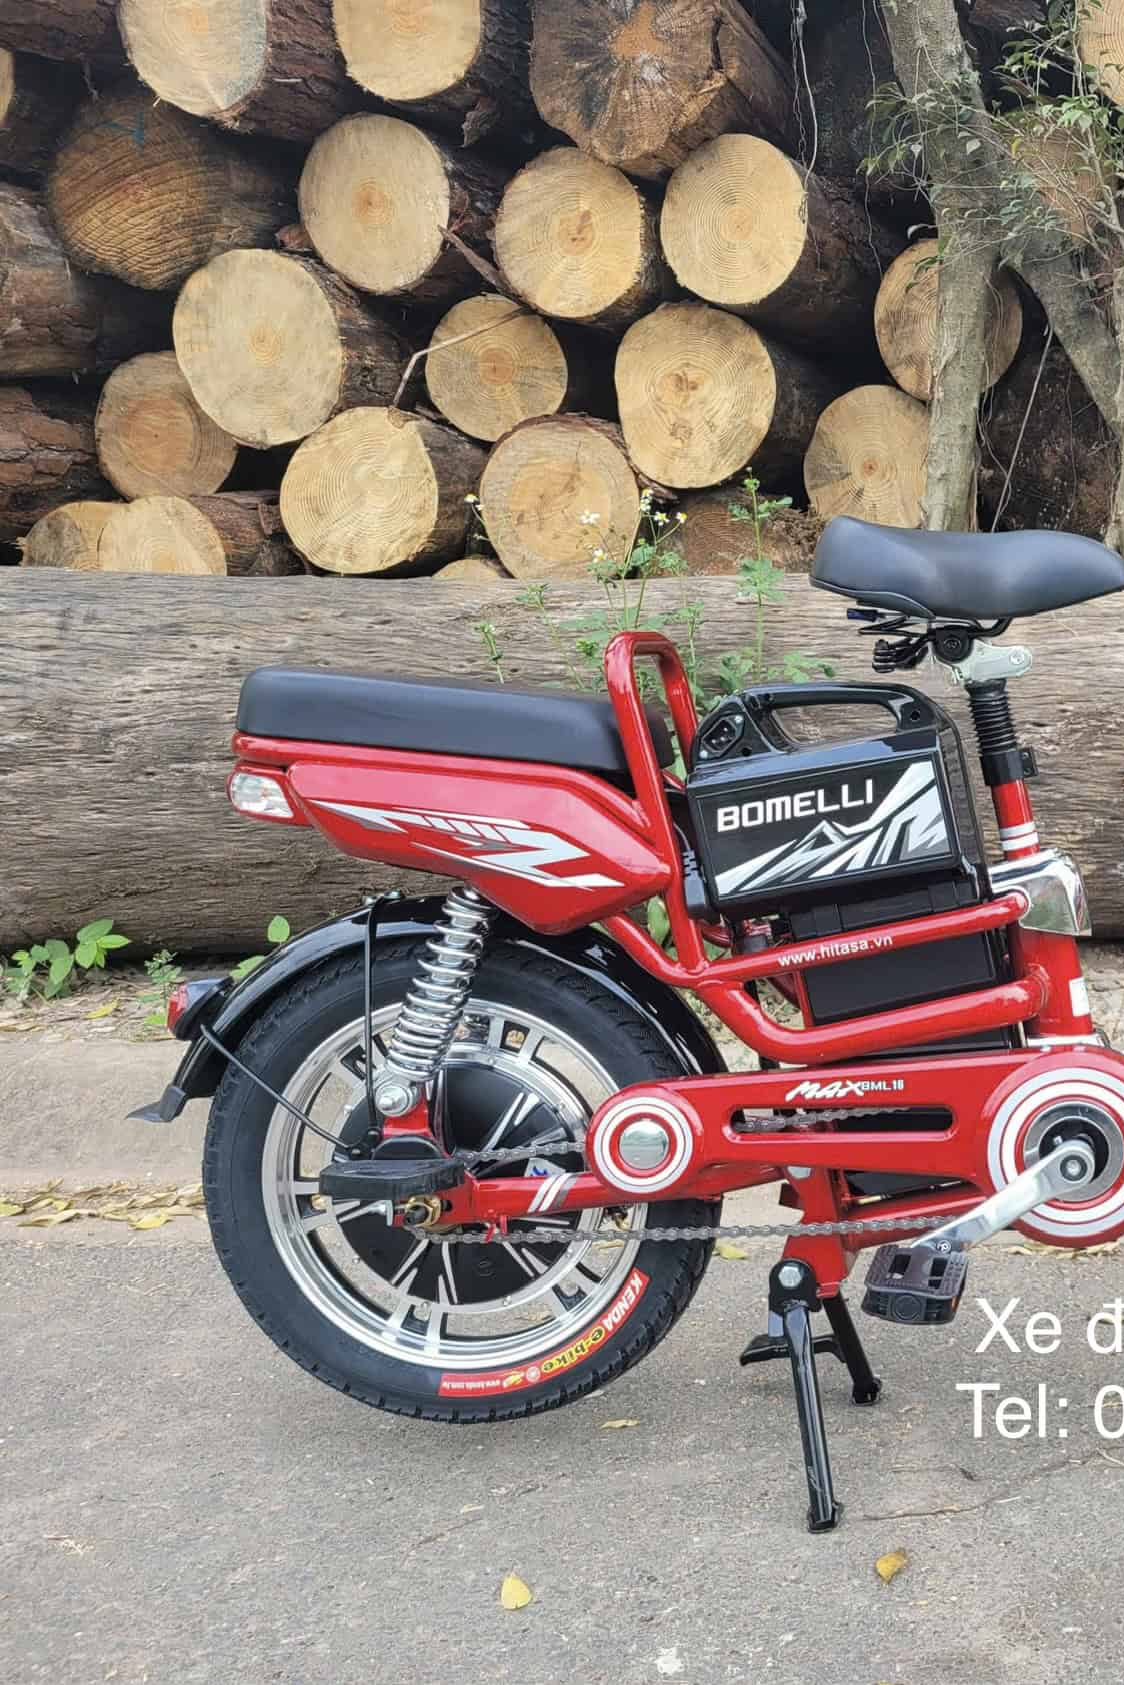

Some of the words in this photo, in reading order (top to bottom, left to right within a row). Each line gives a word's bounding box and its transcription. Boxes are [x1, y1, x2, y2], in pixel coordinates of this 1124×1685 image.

[716, 778, 874, 833] BOMELLI
[778, 935, 893, 967] www.hitasa.vn
[785, 1079, 865, 1102] MAX
[602, 1272, 644, 1332] KENDA
[541, 1325, 606, 1373] e-bike
